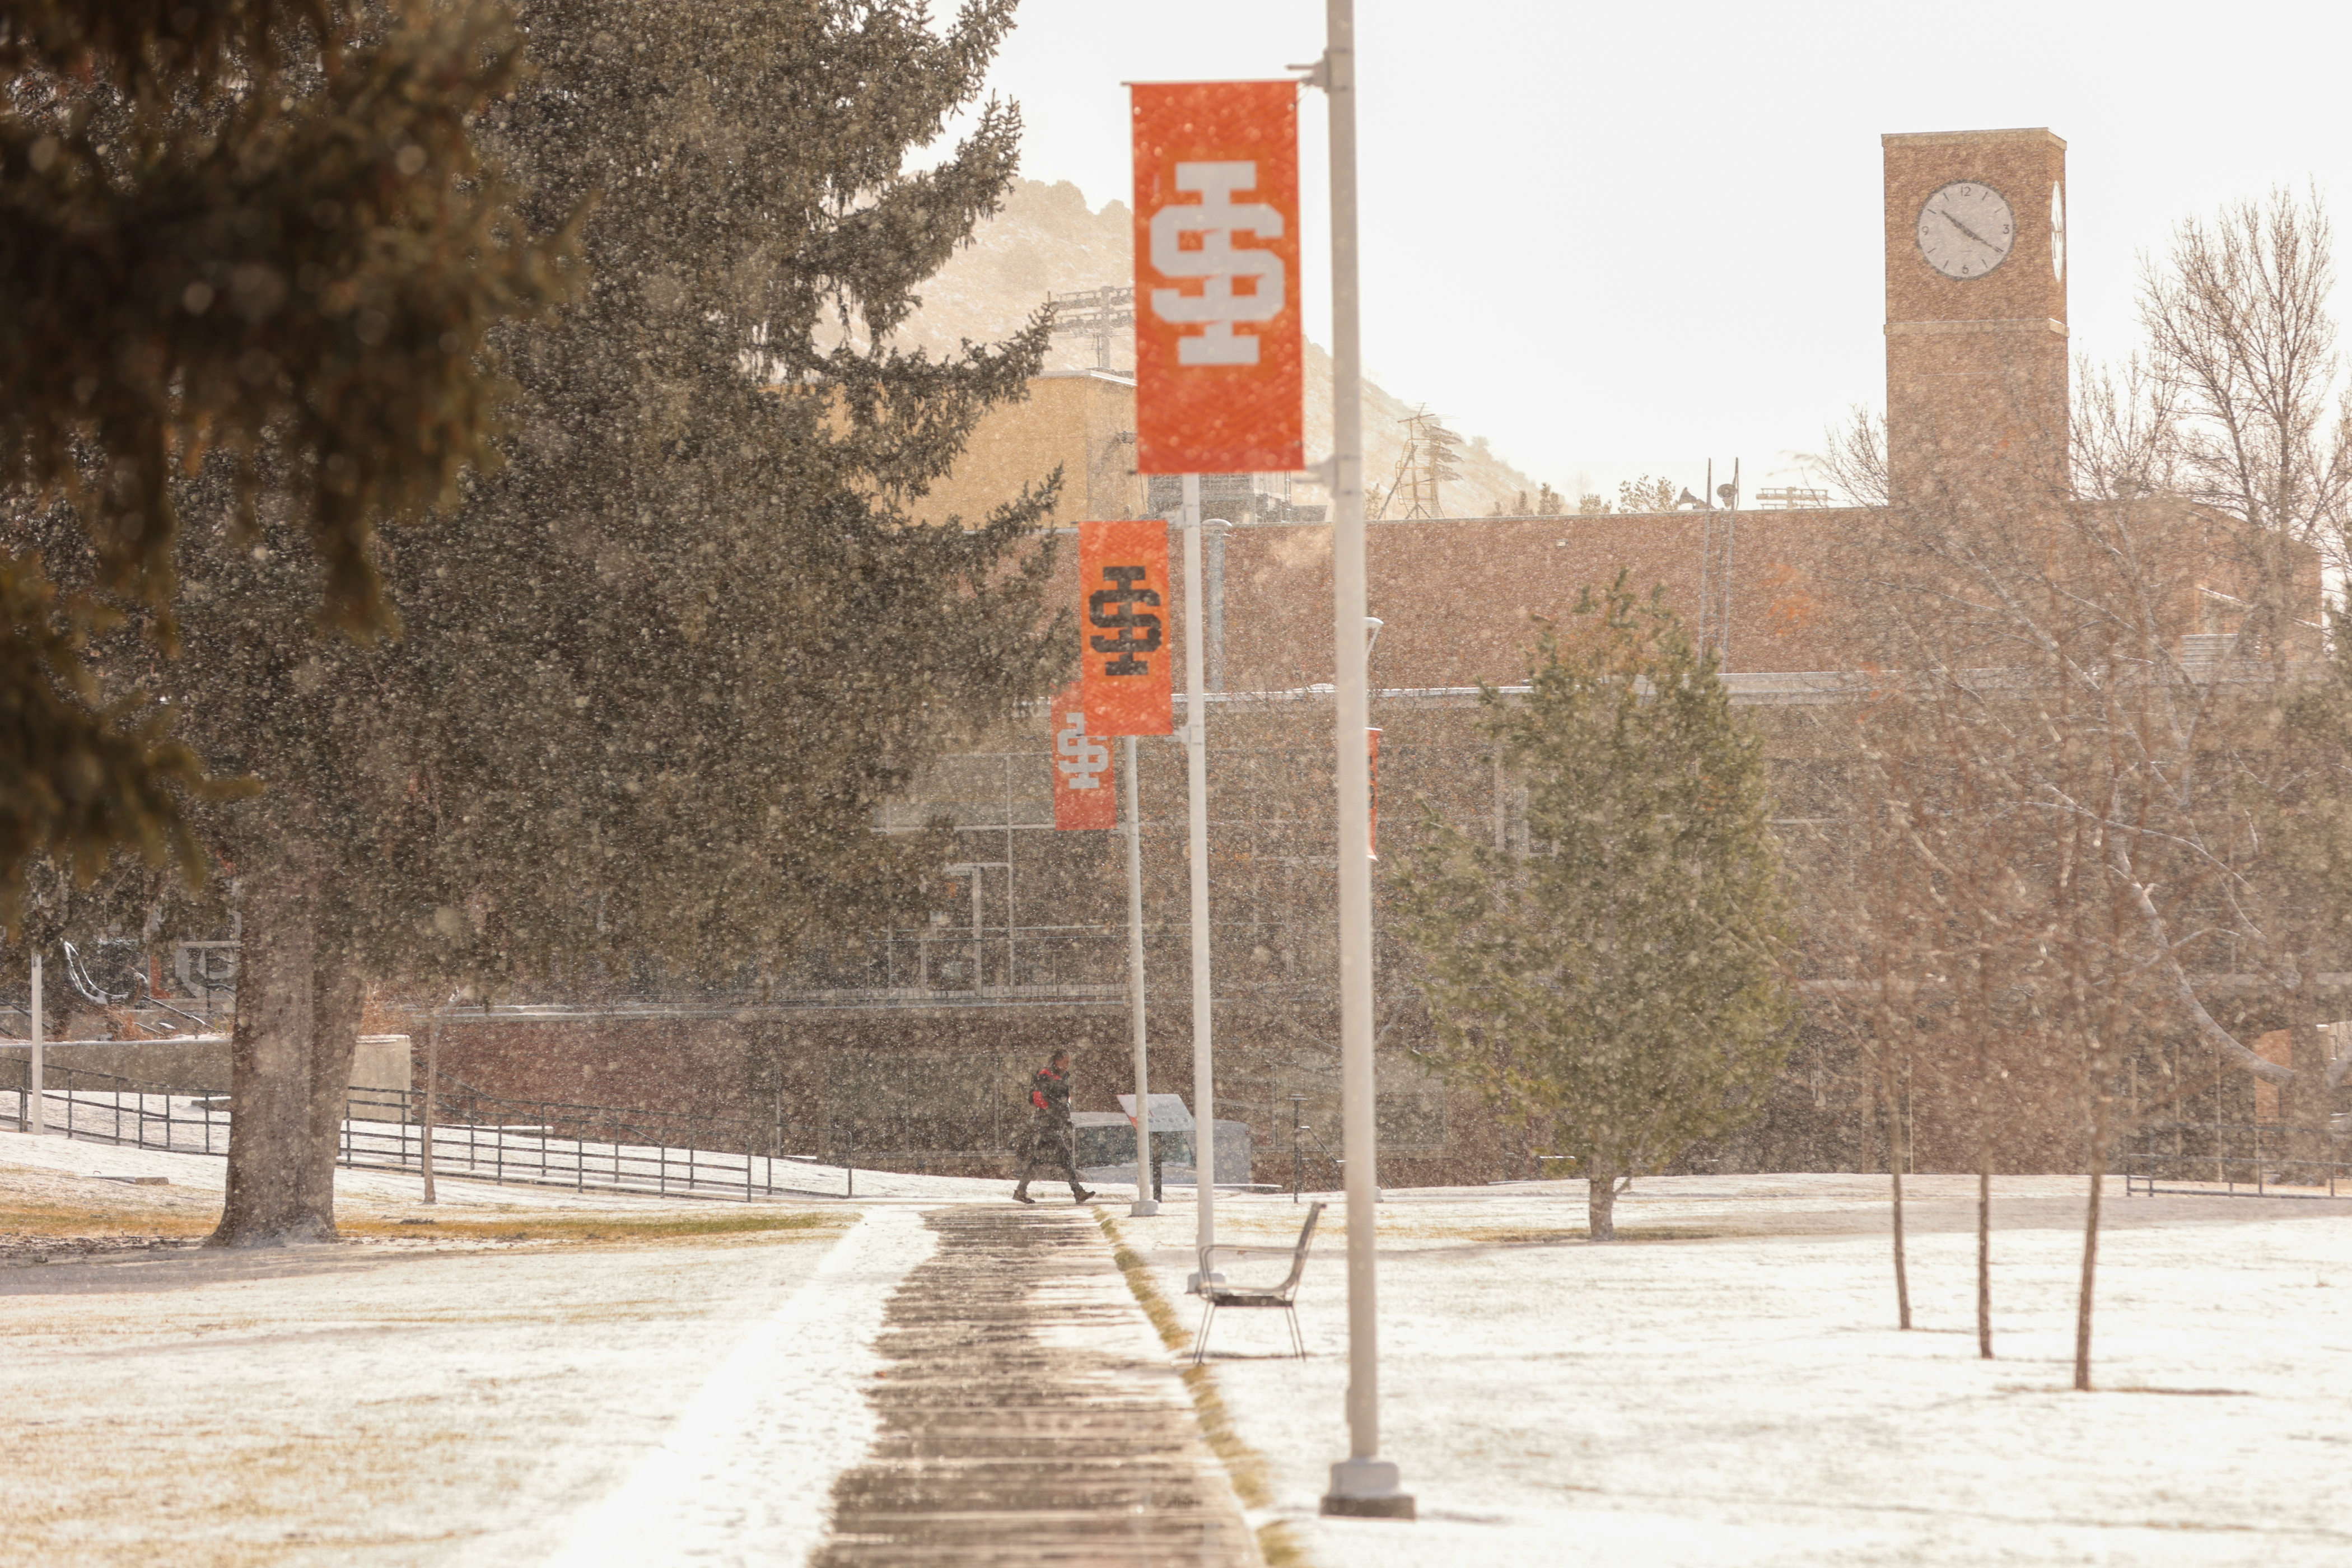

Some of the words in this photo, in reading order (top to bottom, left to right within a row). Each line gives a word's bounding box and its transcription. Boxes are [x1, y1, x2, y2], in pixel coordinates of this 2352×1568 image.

[1961, 186, 1971, 197] 12
[1921, 226, 1929, 236] 9
[2002, 224, 2010, 235] 3
[1962, 264, 1970, 274] 6
